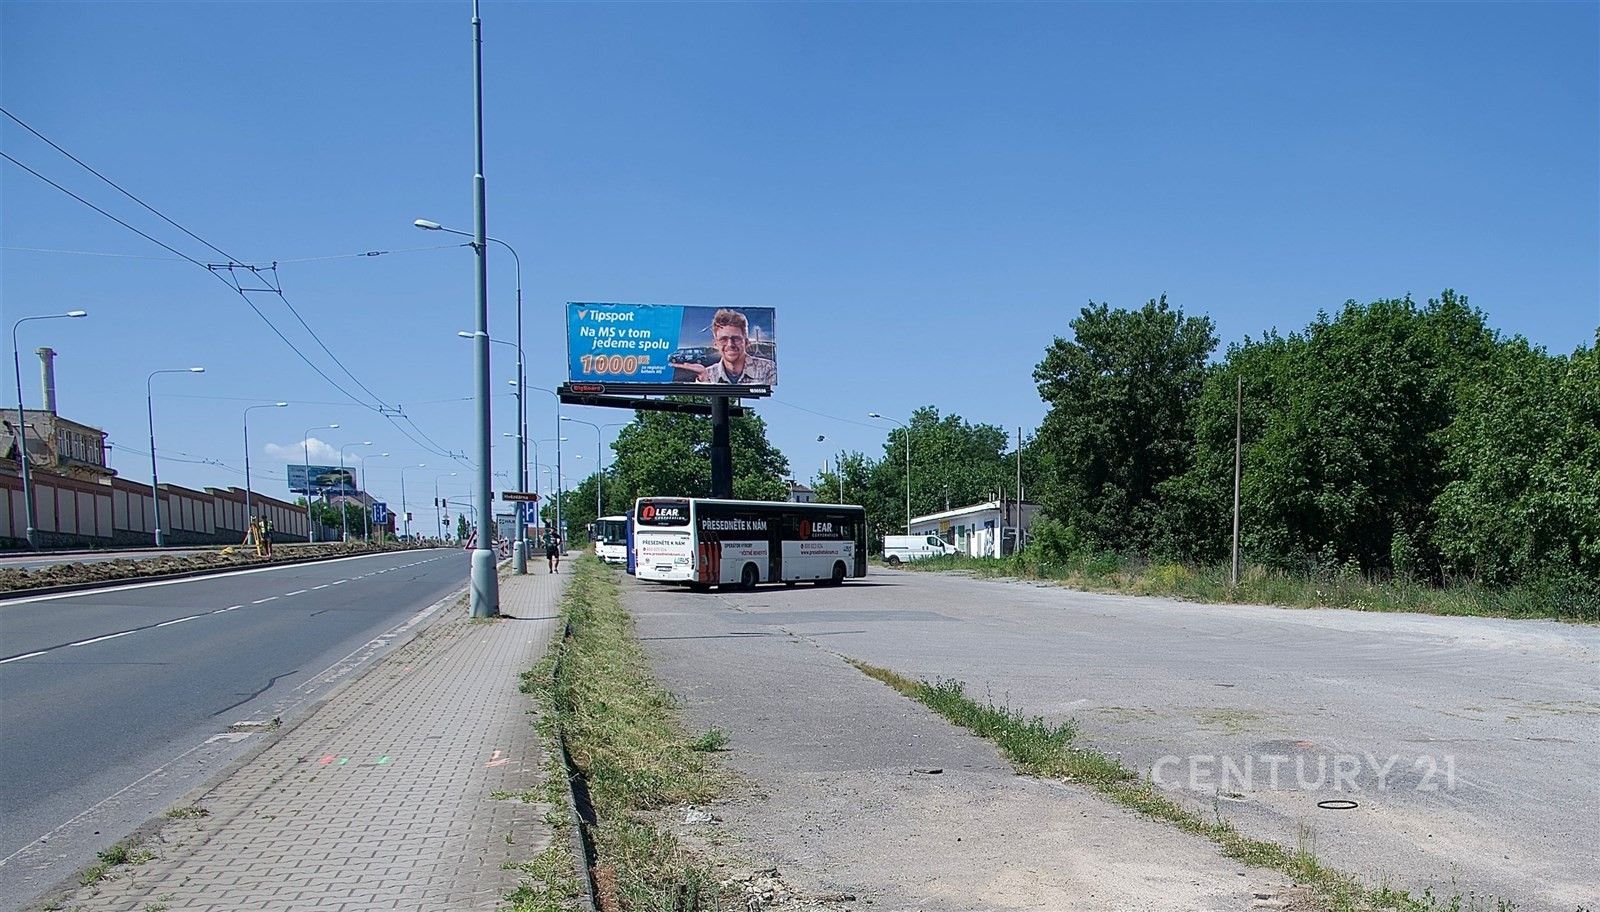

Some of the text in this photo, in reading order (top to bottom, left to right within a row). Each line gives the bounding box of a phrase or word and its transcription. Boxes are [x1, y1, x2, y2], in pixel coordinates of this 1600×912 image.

[590, 310, 634, 322] Tipsport
[580, 327, 595, 336] Na
[598, 327, 616, 337] MS
[628, 328, 650, 338] tom
[592, 337, 669, 351] jedeme spolu
[581, 355, 637, 374] 1000
[656, 508, 679, 516] LEAR
[702, 518, 767, 530] PŘESEDNĚTE K NÁM
[812, 522, 833, 532] LEAR
